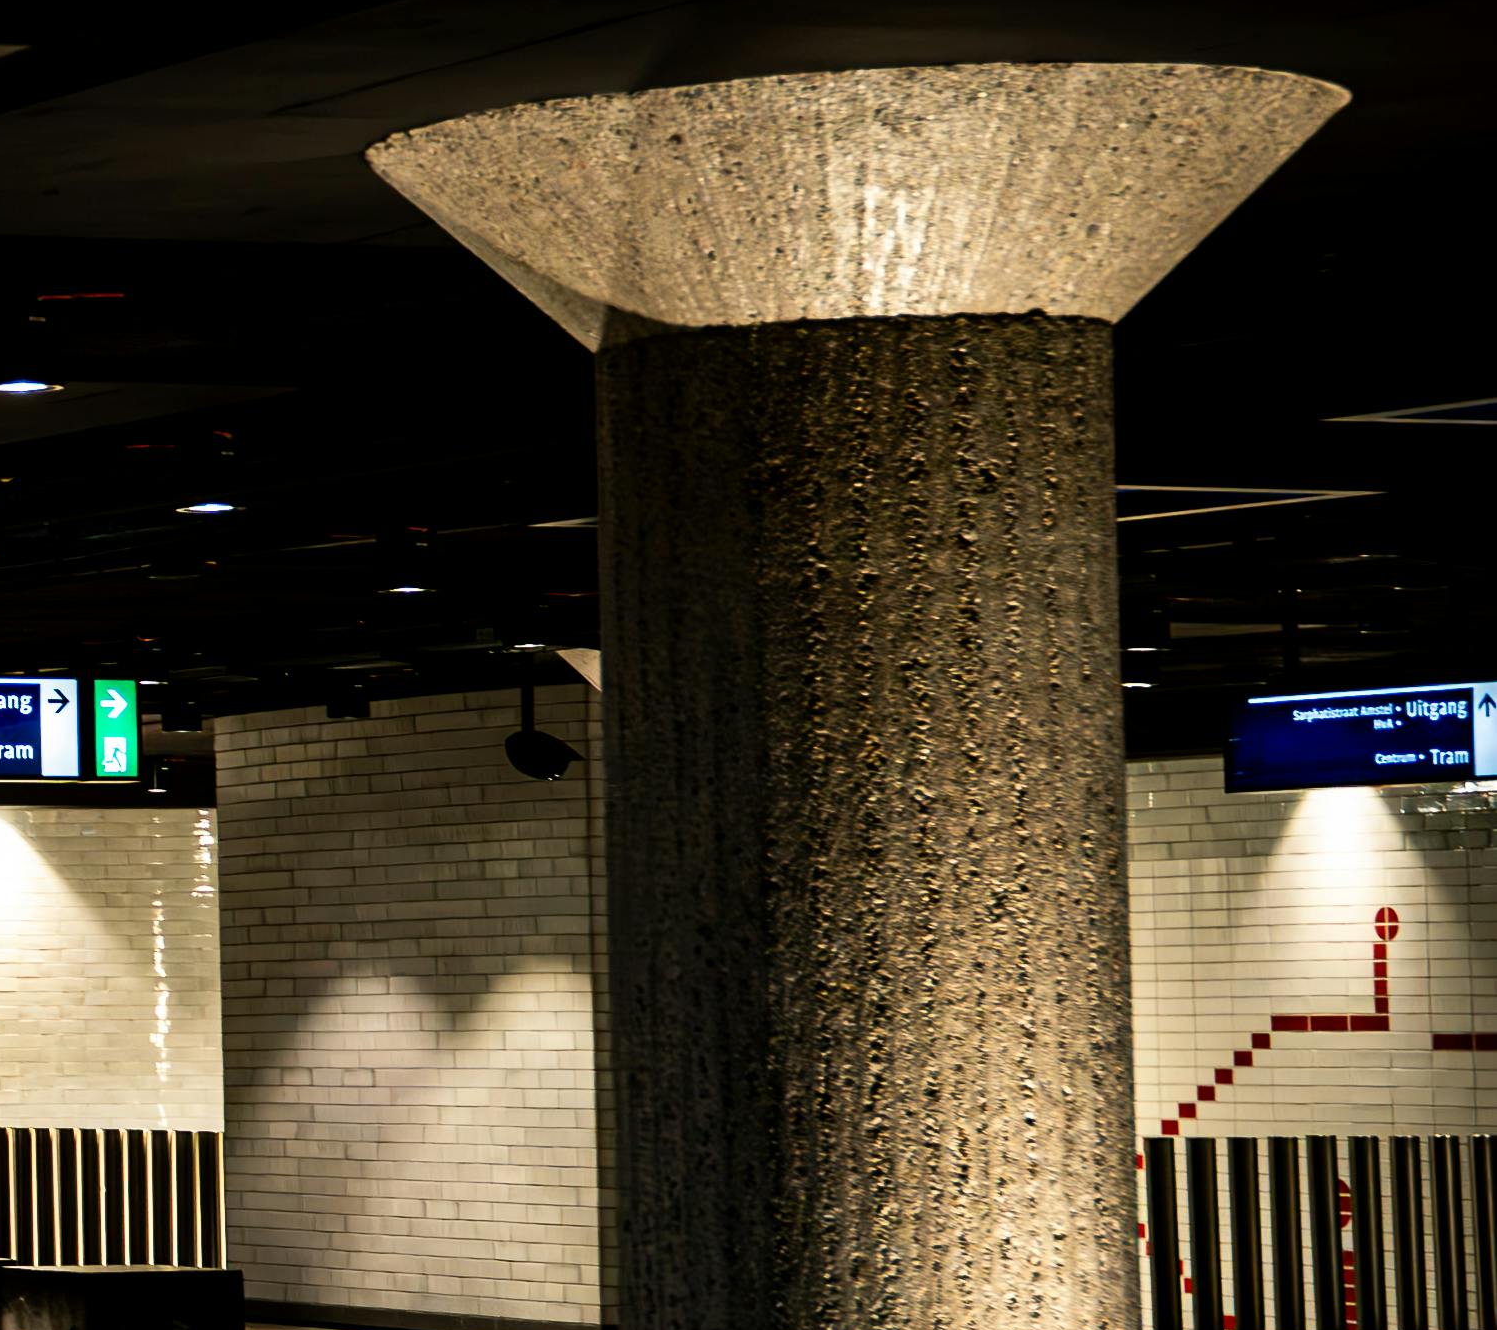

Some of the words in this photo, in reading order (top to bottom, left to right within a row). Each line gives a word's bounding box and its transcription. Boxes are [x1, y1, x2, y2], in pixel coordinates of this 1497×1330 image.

[1292, 707, 1359, 723] Sarphatistraat
[1360, 703, 1393, 716] Amstel
[1406, 699, 1467, 721] Uitgang
[1429, 748, 1469, 765] Tram
